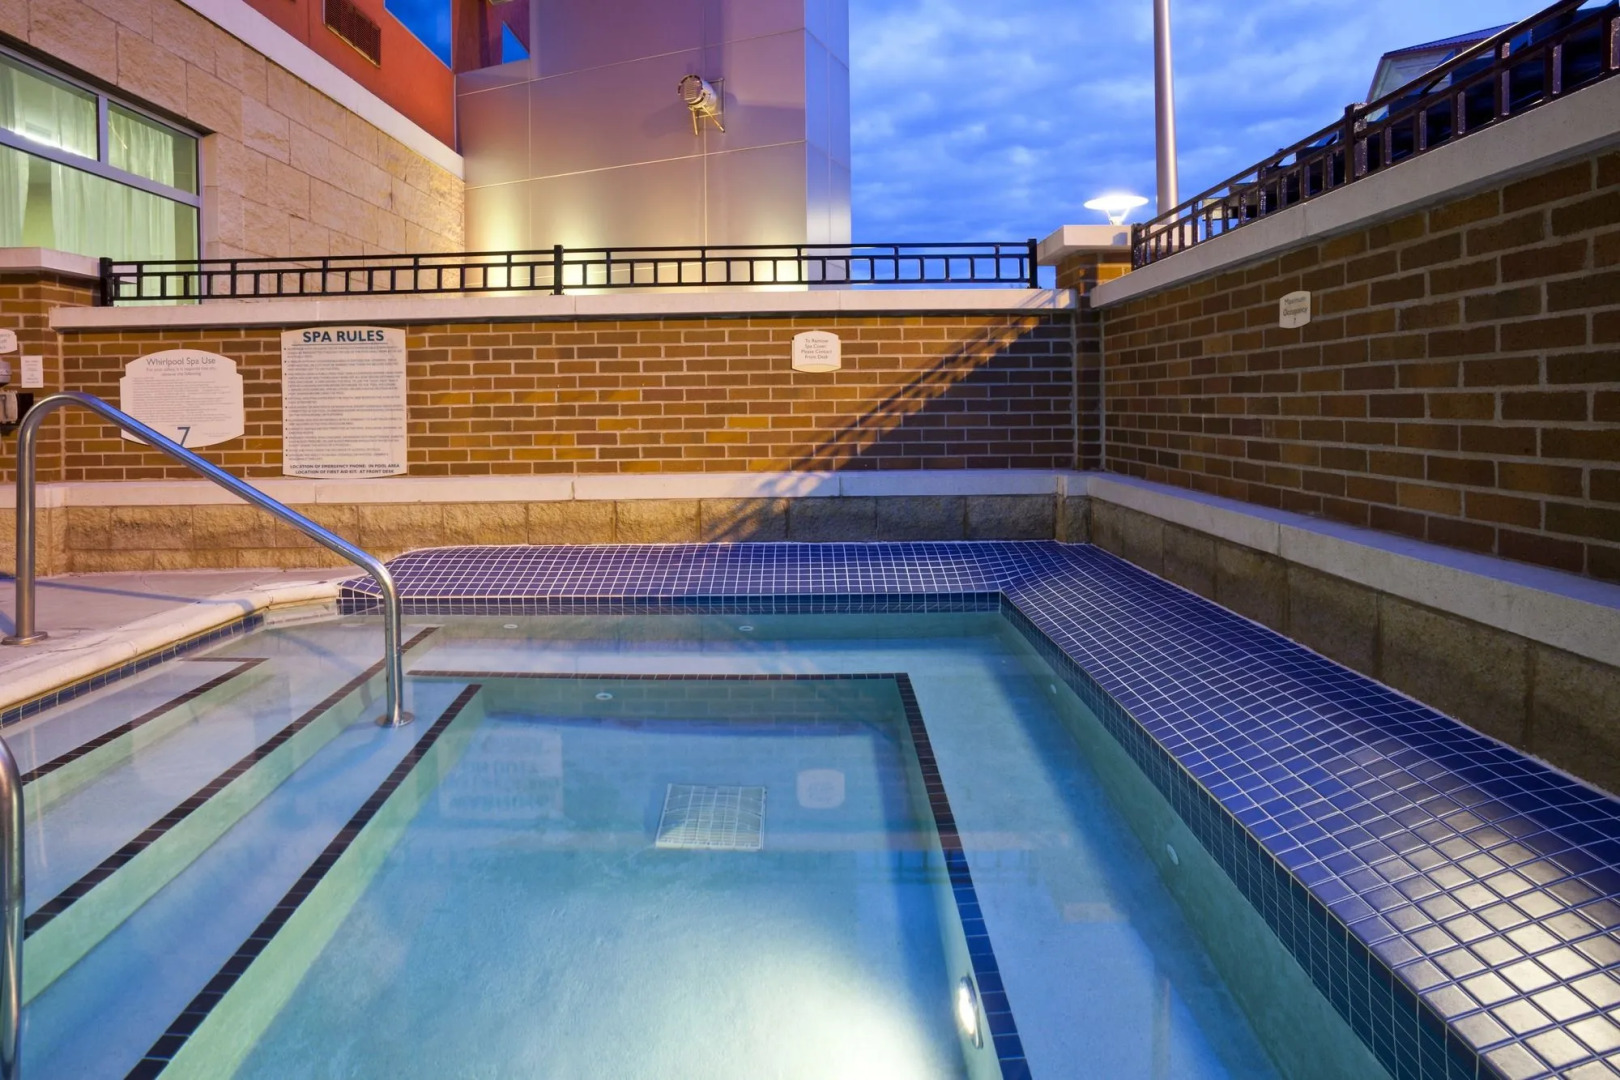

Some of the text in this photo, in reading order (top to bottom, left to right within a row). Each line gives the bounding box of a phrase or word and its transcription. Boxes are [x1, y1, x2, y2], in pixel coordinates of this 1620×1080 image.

[1283, 307, 1308, 316] Occupancy
[303, 330, 384, 343] SPA RULES
[146, 357, 216, 367] Whirlpool Spa Use
[177, 426, 191, 446] 7
